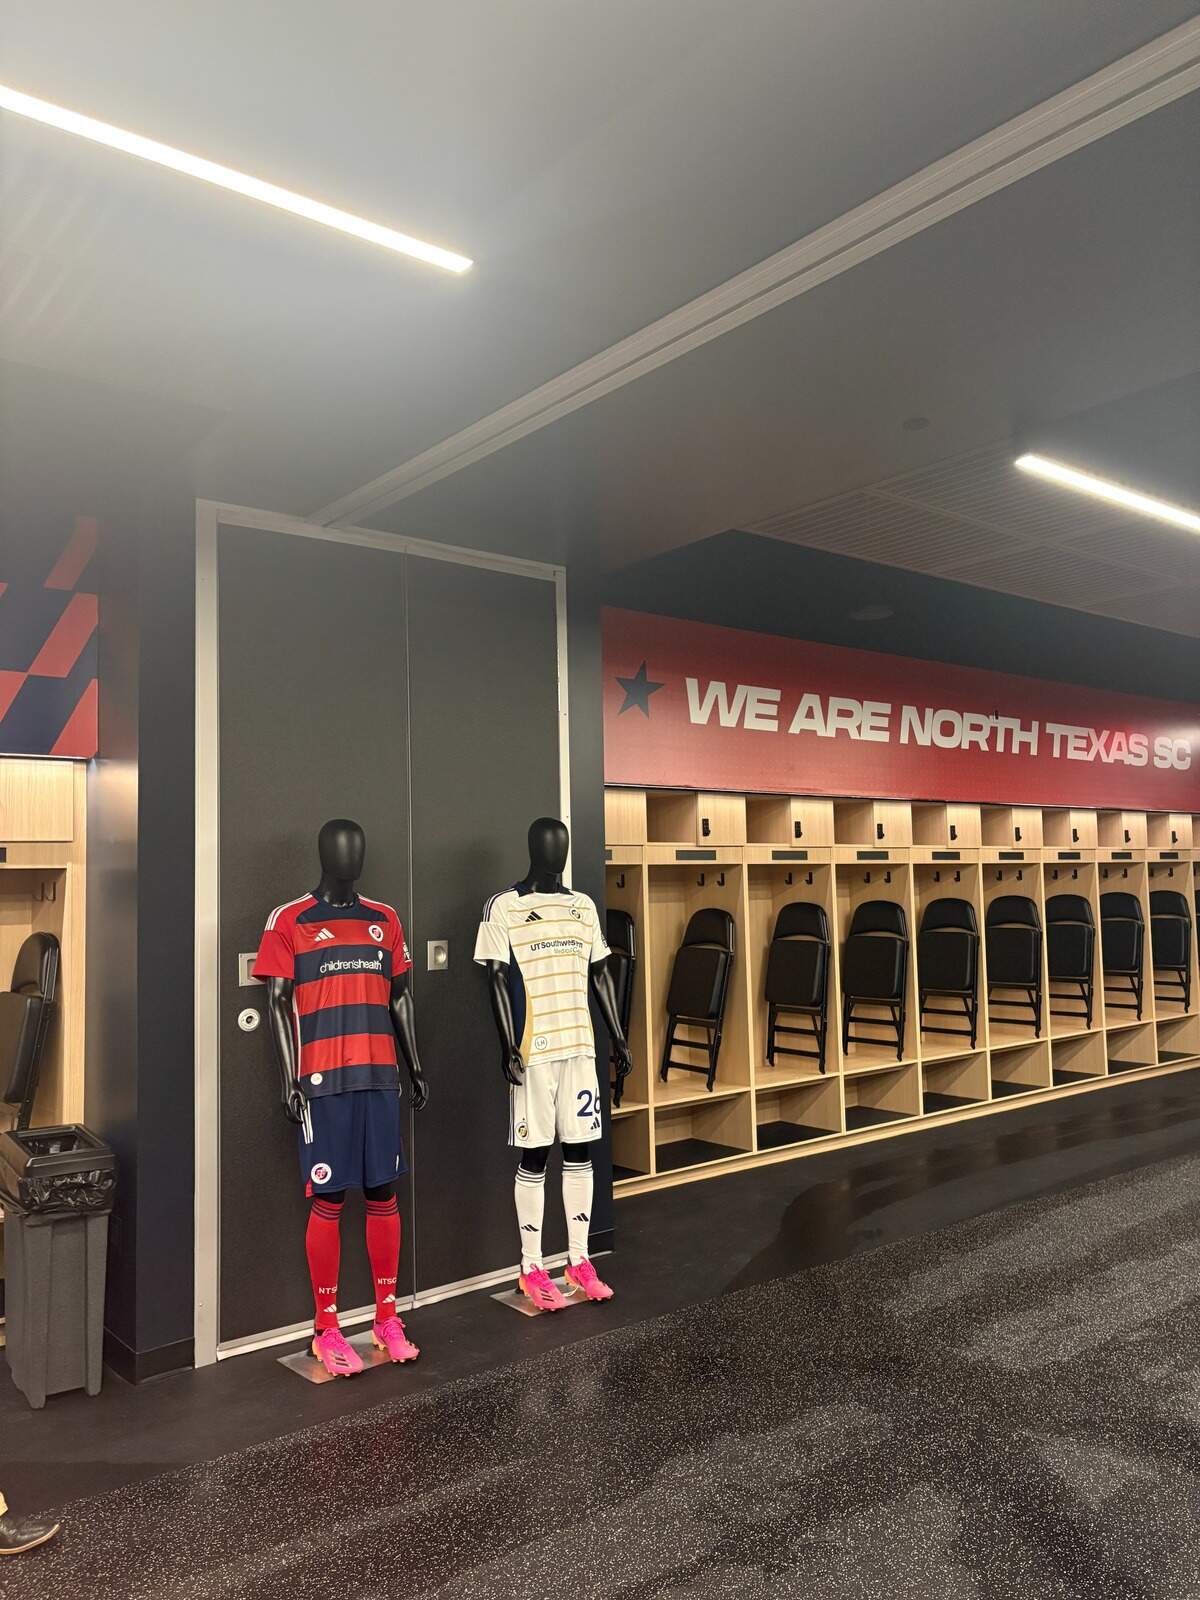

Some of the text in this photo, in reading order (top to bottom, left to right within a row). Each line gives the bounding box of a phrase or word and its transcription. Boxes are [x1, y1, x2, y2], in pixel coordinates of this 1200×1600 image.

[685, 677, 1192, 771] WE ARE NORTH TEXAS SC
[318, 1284, 338, 1295] NTS
